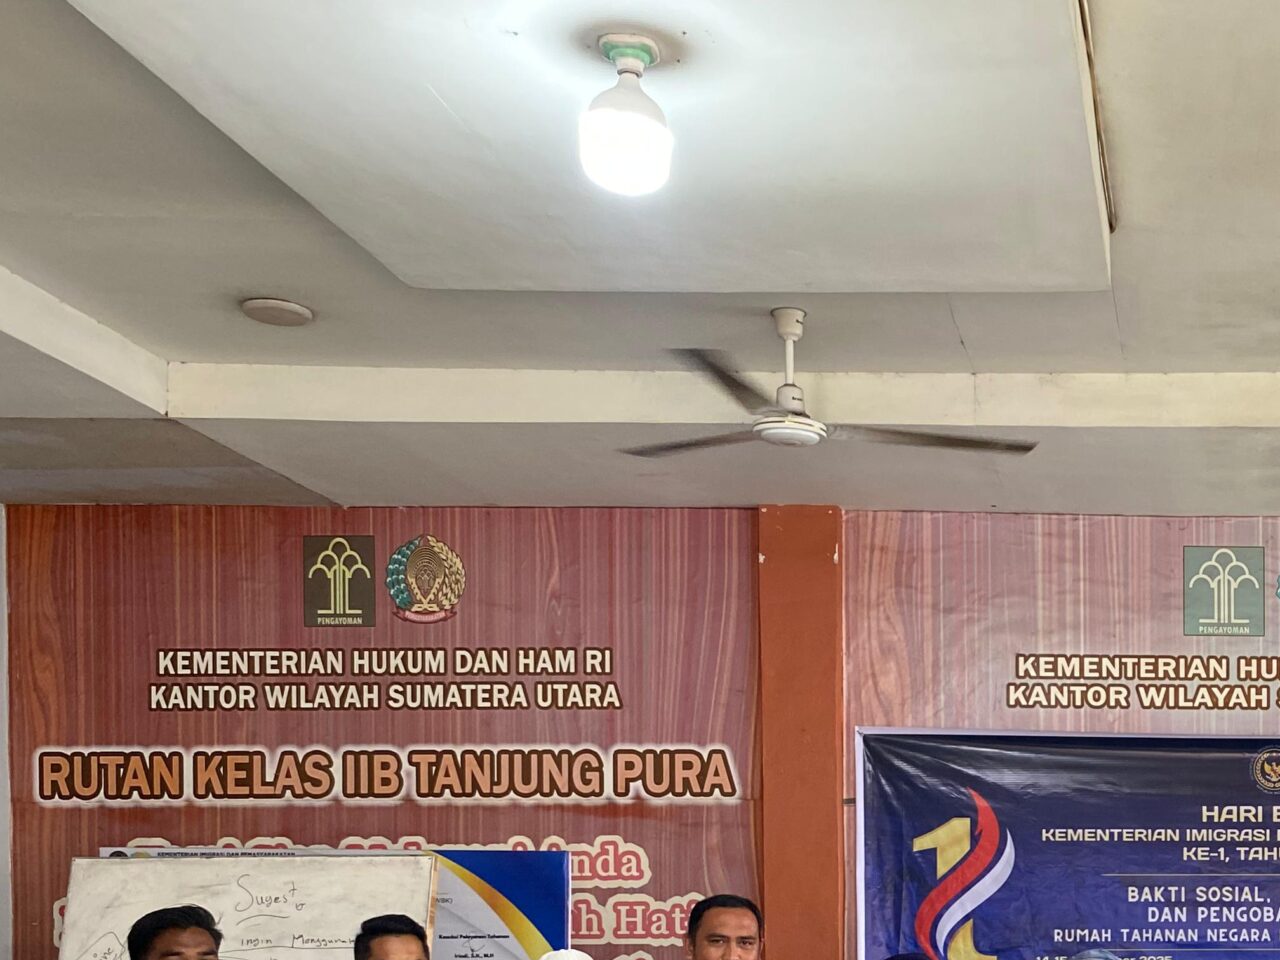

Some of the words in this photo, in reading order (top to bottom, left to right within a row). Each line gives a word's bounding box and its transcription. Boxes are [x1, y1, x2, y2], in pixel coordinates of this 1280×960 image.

[317, 617, 363, 625] PENGAYOMAN
[1198, 626, 1250, 634] PENGAYOMAN
[158, 650, 342, 675] KEMENTERIAN
[352, 650, 445, 674] HUKUM
[455, 650, 508, 674] DAN
[518, 649, 575, 673] HAM
[585, 649, 611, 673] RI
[1018, 656, 1228, 680] KEMENTERIAN
[149, 685, 256, 709] KANTOR
[264, 685, 379, 709] WILAYAH
[387, 685, 527, 709] SUMATERA
[536, 684, 621, 708] UTARA
[1007, 686, 1129, 709] KANTOR
[1138, 686, 1269, 710] WILAYAH
[41, 754, 182, 797] RUTAN
[192, 754, 335, 797] KELAS
[343, 754, 400, 796] IIB
[411, 753, 601, 796] TANJUNG
[613, 752, 737, 795] PURA
[1201, 805, 1263, 823] HARI
[1041, 828, 1180, 841] KEMENTERIAN
[1185, 828, 1271, 841] IMIGRASI
[572, 845, 641, 877] nda
[1182, 846, 1230, 863] KE-1,
[1127, 886, 1186, 903] BAKTI
[1195, 886, 1271, 904] SOSIAL,
[617, 905, 689, 936] Hat
[1147, 907, 1187, 922] DAN
[1053, 928, 1112, 942] RUMAH
[1121, 928, 1199, 942] TAHANAN
[1207, 928, 1271, 942] NEGARA
